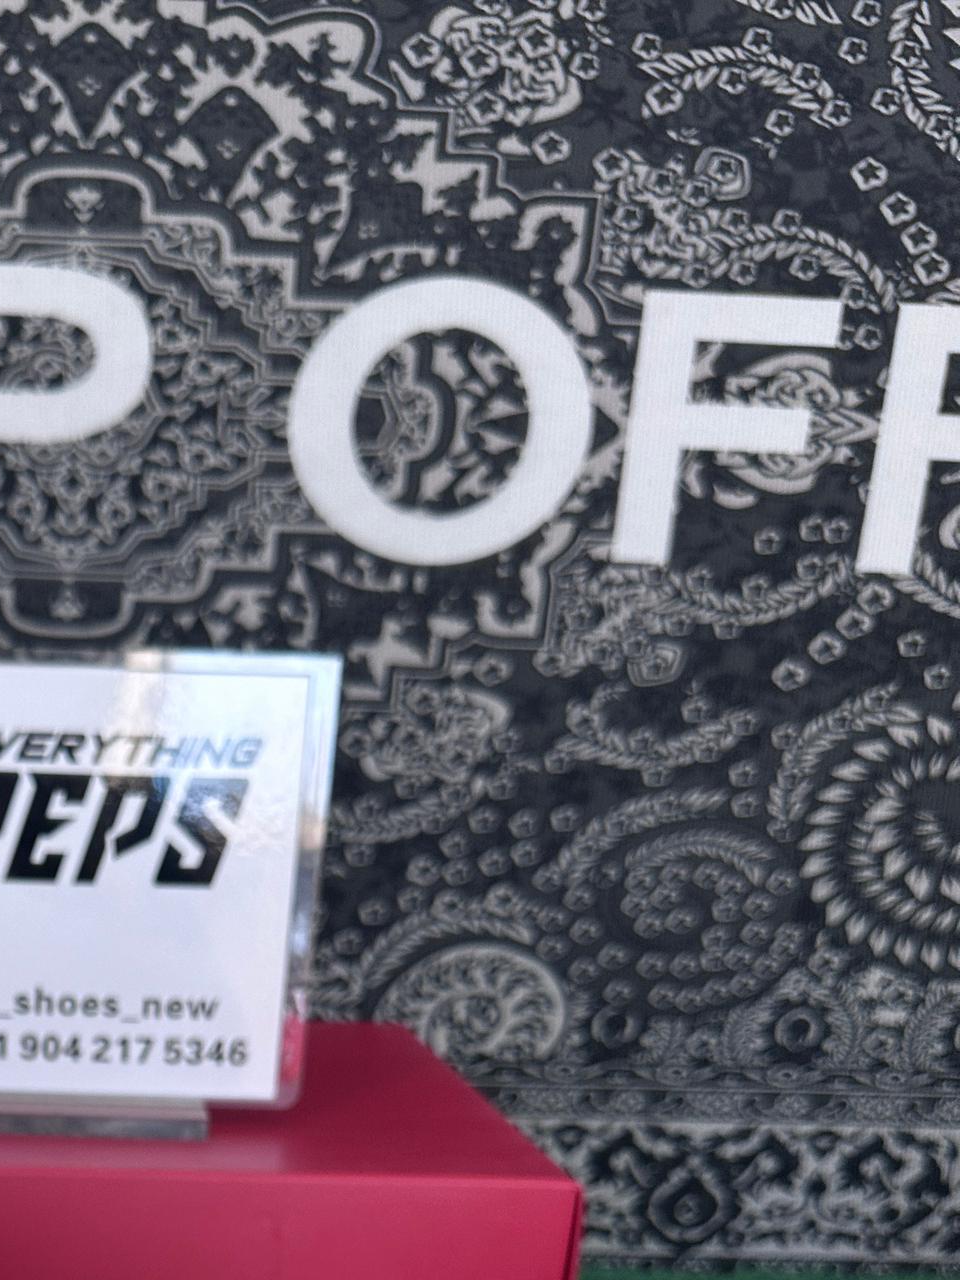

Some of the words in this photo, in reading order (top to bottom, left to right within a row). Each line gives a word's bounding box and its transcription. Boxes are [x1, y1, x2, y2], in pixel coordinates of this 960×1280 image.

[19, 1033, 82, 1063] 904
[91, 1035, 154, 1065] 217
[163, 1038, 249, 1067] 5346
